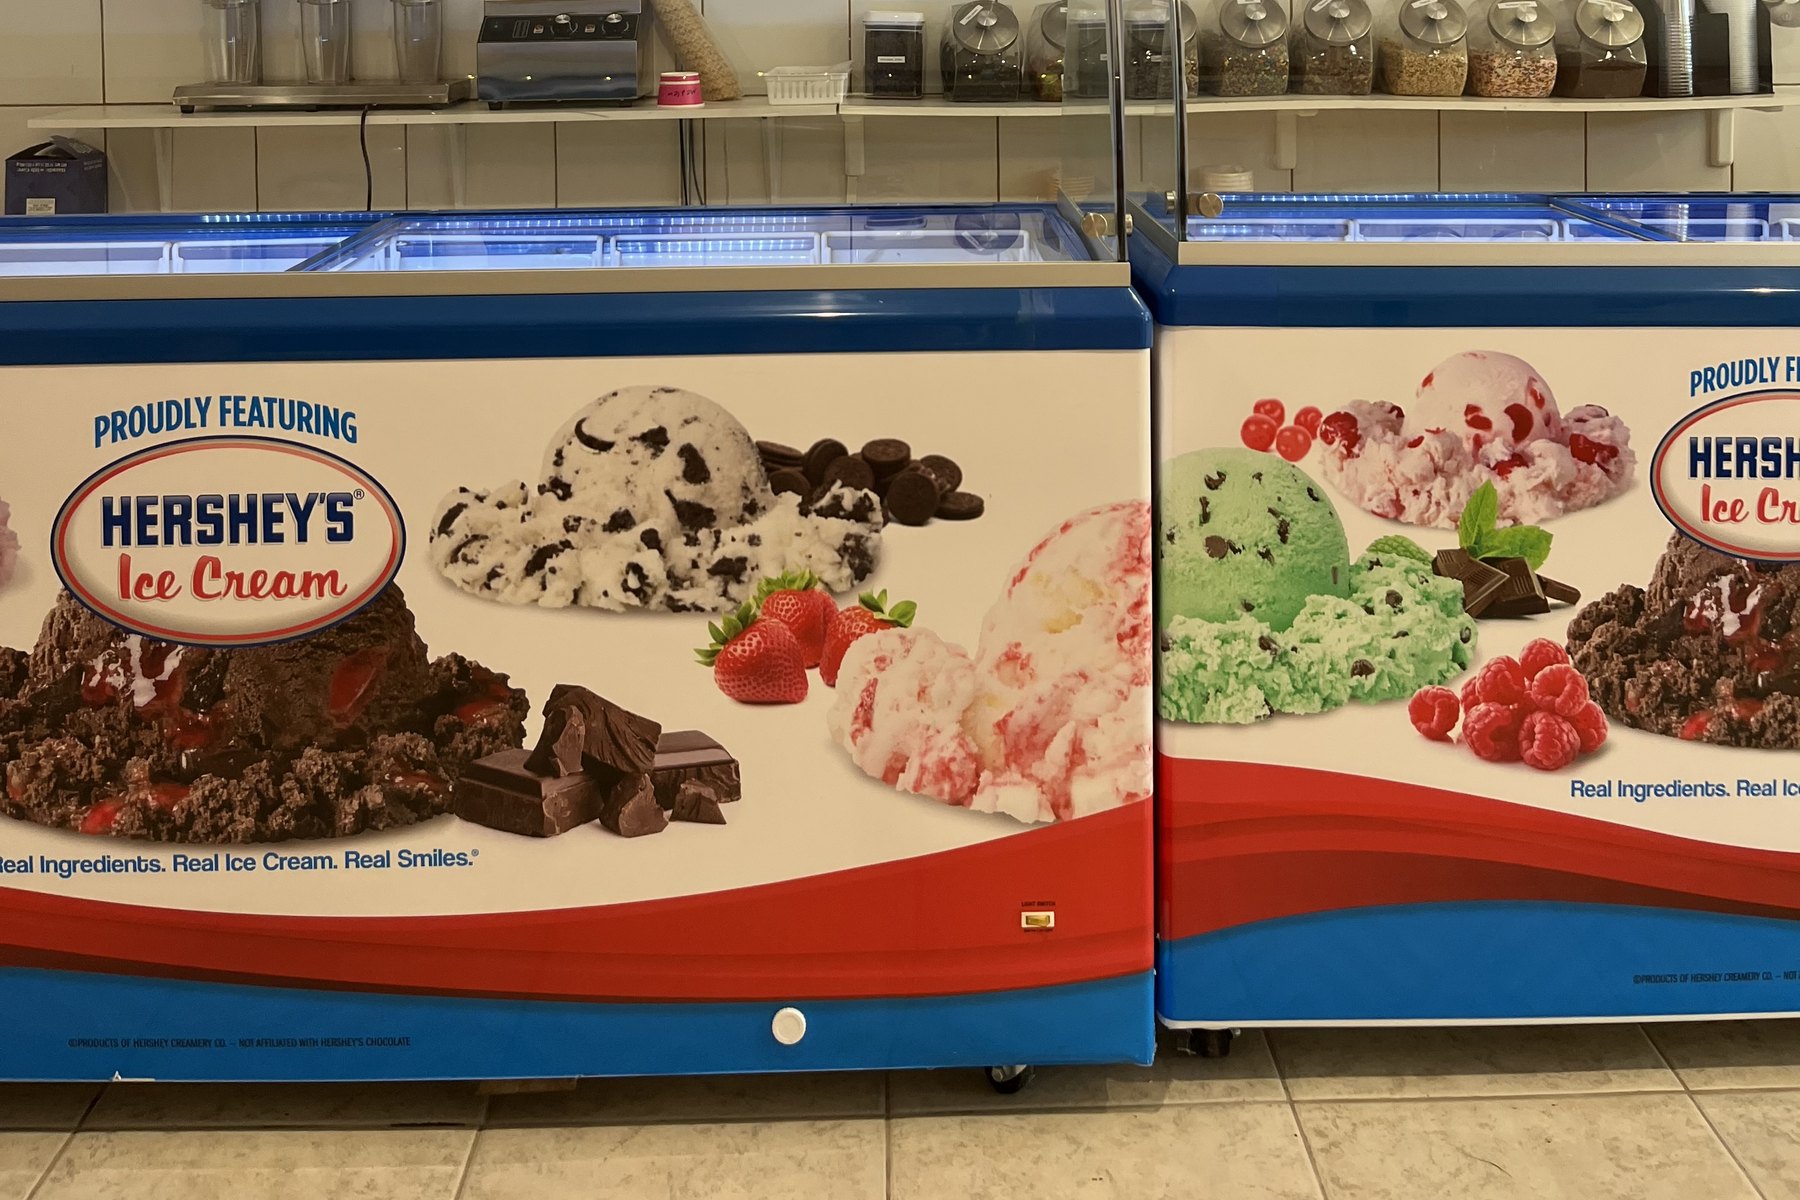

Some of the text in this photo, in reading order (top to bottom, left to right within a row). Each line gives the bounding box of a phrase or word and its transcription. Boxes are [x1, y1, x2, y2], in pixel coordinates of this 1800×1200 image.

[1690, 356, 1800, 398] PROUDLY F
[94, 394, 358, 449] PROUDLY FEATURING
[1701, 482, 1750, 524] Ice
[118, 552, 349, 602] Ice Cream
[1570, 779, 1800, 803] Real Ingredients. Real Ic
[40, 855, 166, 879] Ingredients.
[173, 853, 219, 872] Real
[225, 853, 256, 872] Ice
[262, 851, 338, 871] Cream.
[344, 850, 391, 869] Real
[1679, 974, 1690, 983] OF
